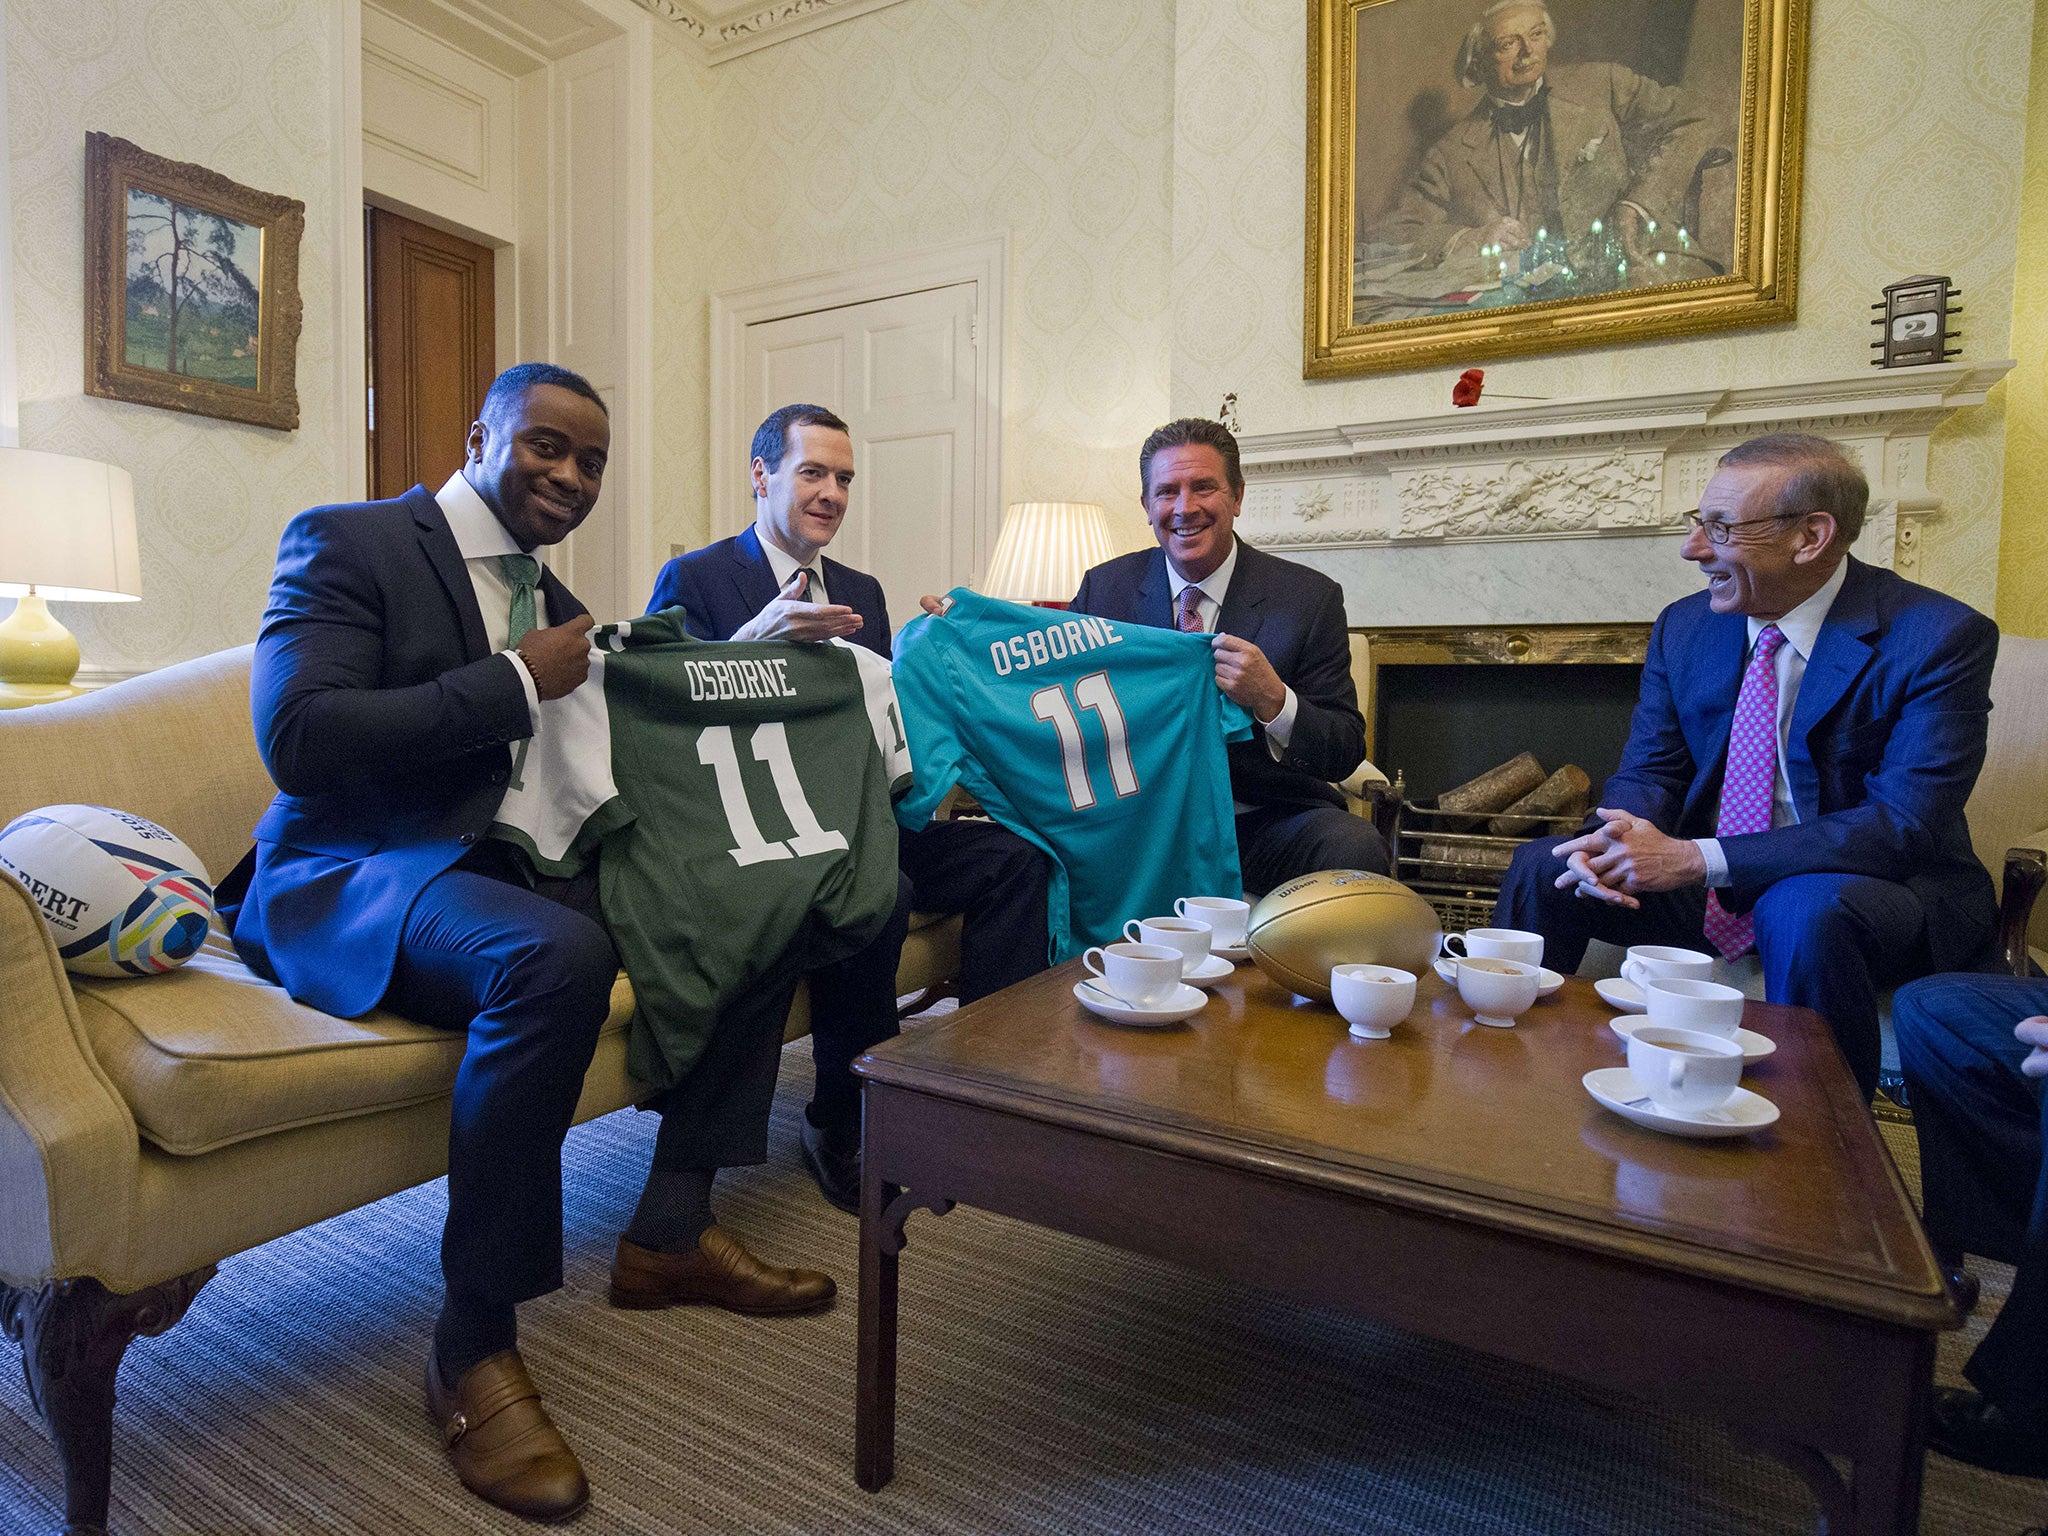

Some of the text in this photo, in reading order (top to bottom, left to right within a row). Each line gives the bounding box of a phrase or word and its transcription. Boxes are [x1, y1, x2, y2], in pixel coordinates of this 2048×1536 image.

[1904, 319, 1927, 340] 2
[990, 617, 1123, 677] OSBORNE
[684, 658, 797, 702] OSBORNE
[1029, 670, 1141, 812] 11
[696, 722, 850, 867] 11
[1278, 879, 1319, 899] Wilson
